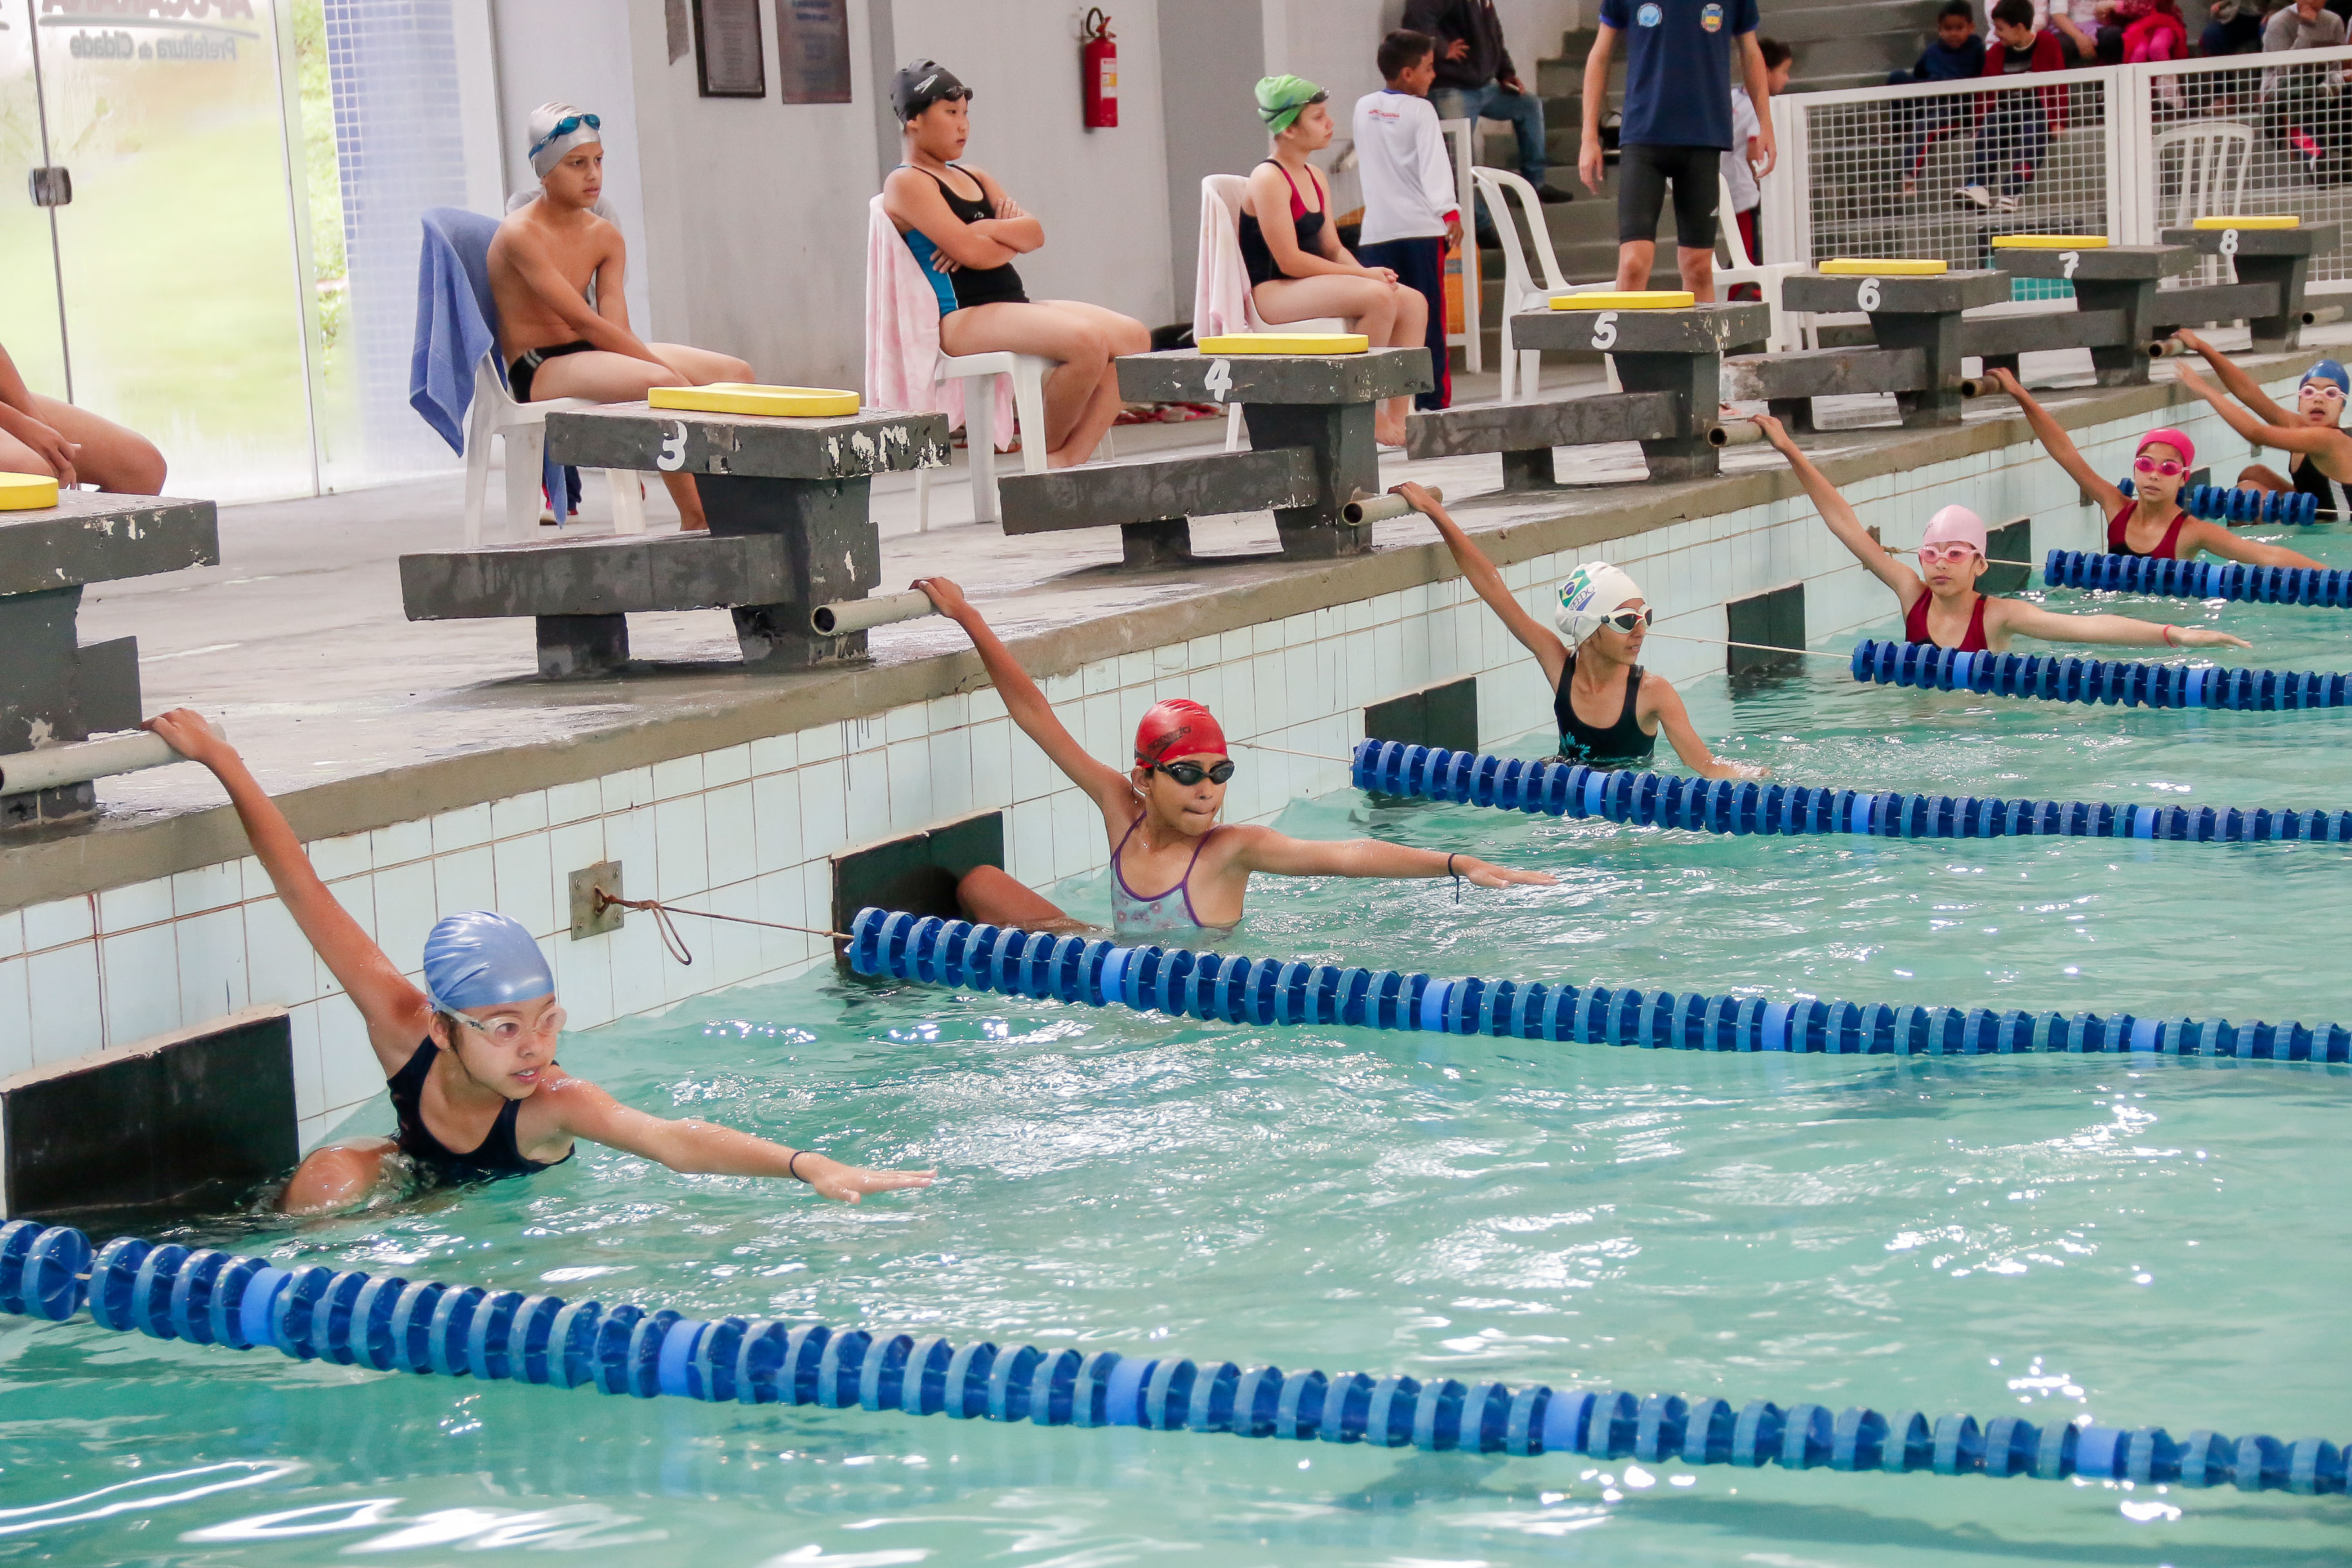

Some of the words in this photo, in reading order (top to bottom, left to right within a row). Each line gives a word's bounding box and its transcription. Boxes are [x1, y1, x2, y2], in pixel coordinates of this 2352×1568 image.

[2220, 229, 2239, 255] 8
[2059, 251, 2079, 279] 7
[1857, 277, 1881, 311] 6
[1591, 311, 1618, 349] 5
[1204, 358, 1233, 402] 4
[656, 420, 688, 471] 3
[1148, 726, 1191, 751] speedo
